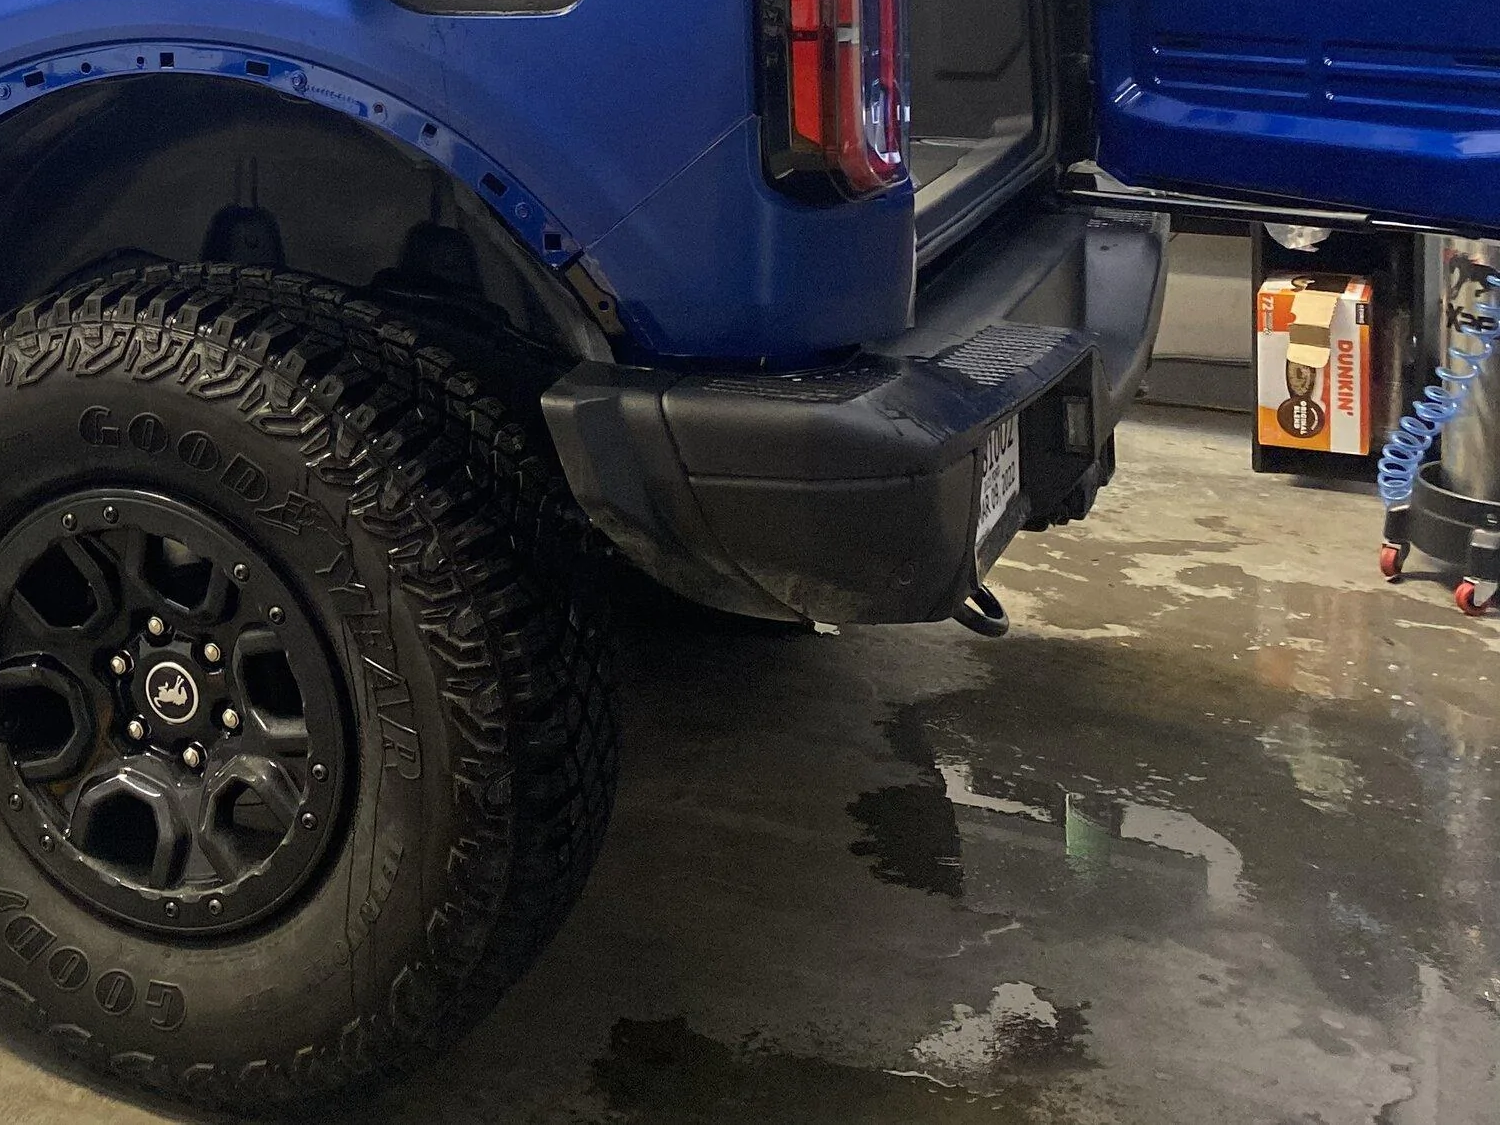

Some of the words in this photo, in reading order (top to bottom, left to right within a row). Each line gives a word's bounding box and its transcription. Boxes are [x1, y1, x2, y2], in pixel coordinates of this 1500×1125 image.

[1261, 296, 1274, 311] 72
[1337, 339, 1354, 417] DUNKIN'
[1300, 400, 1308, 435] ORIGINAL
